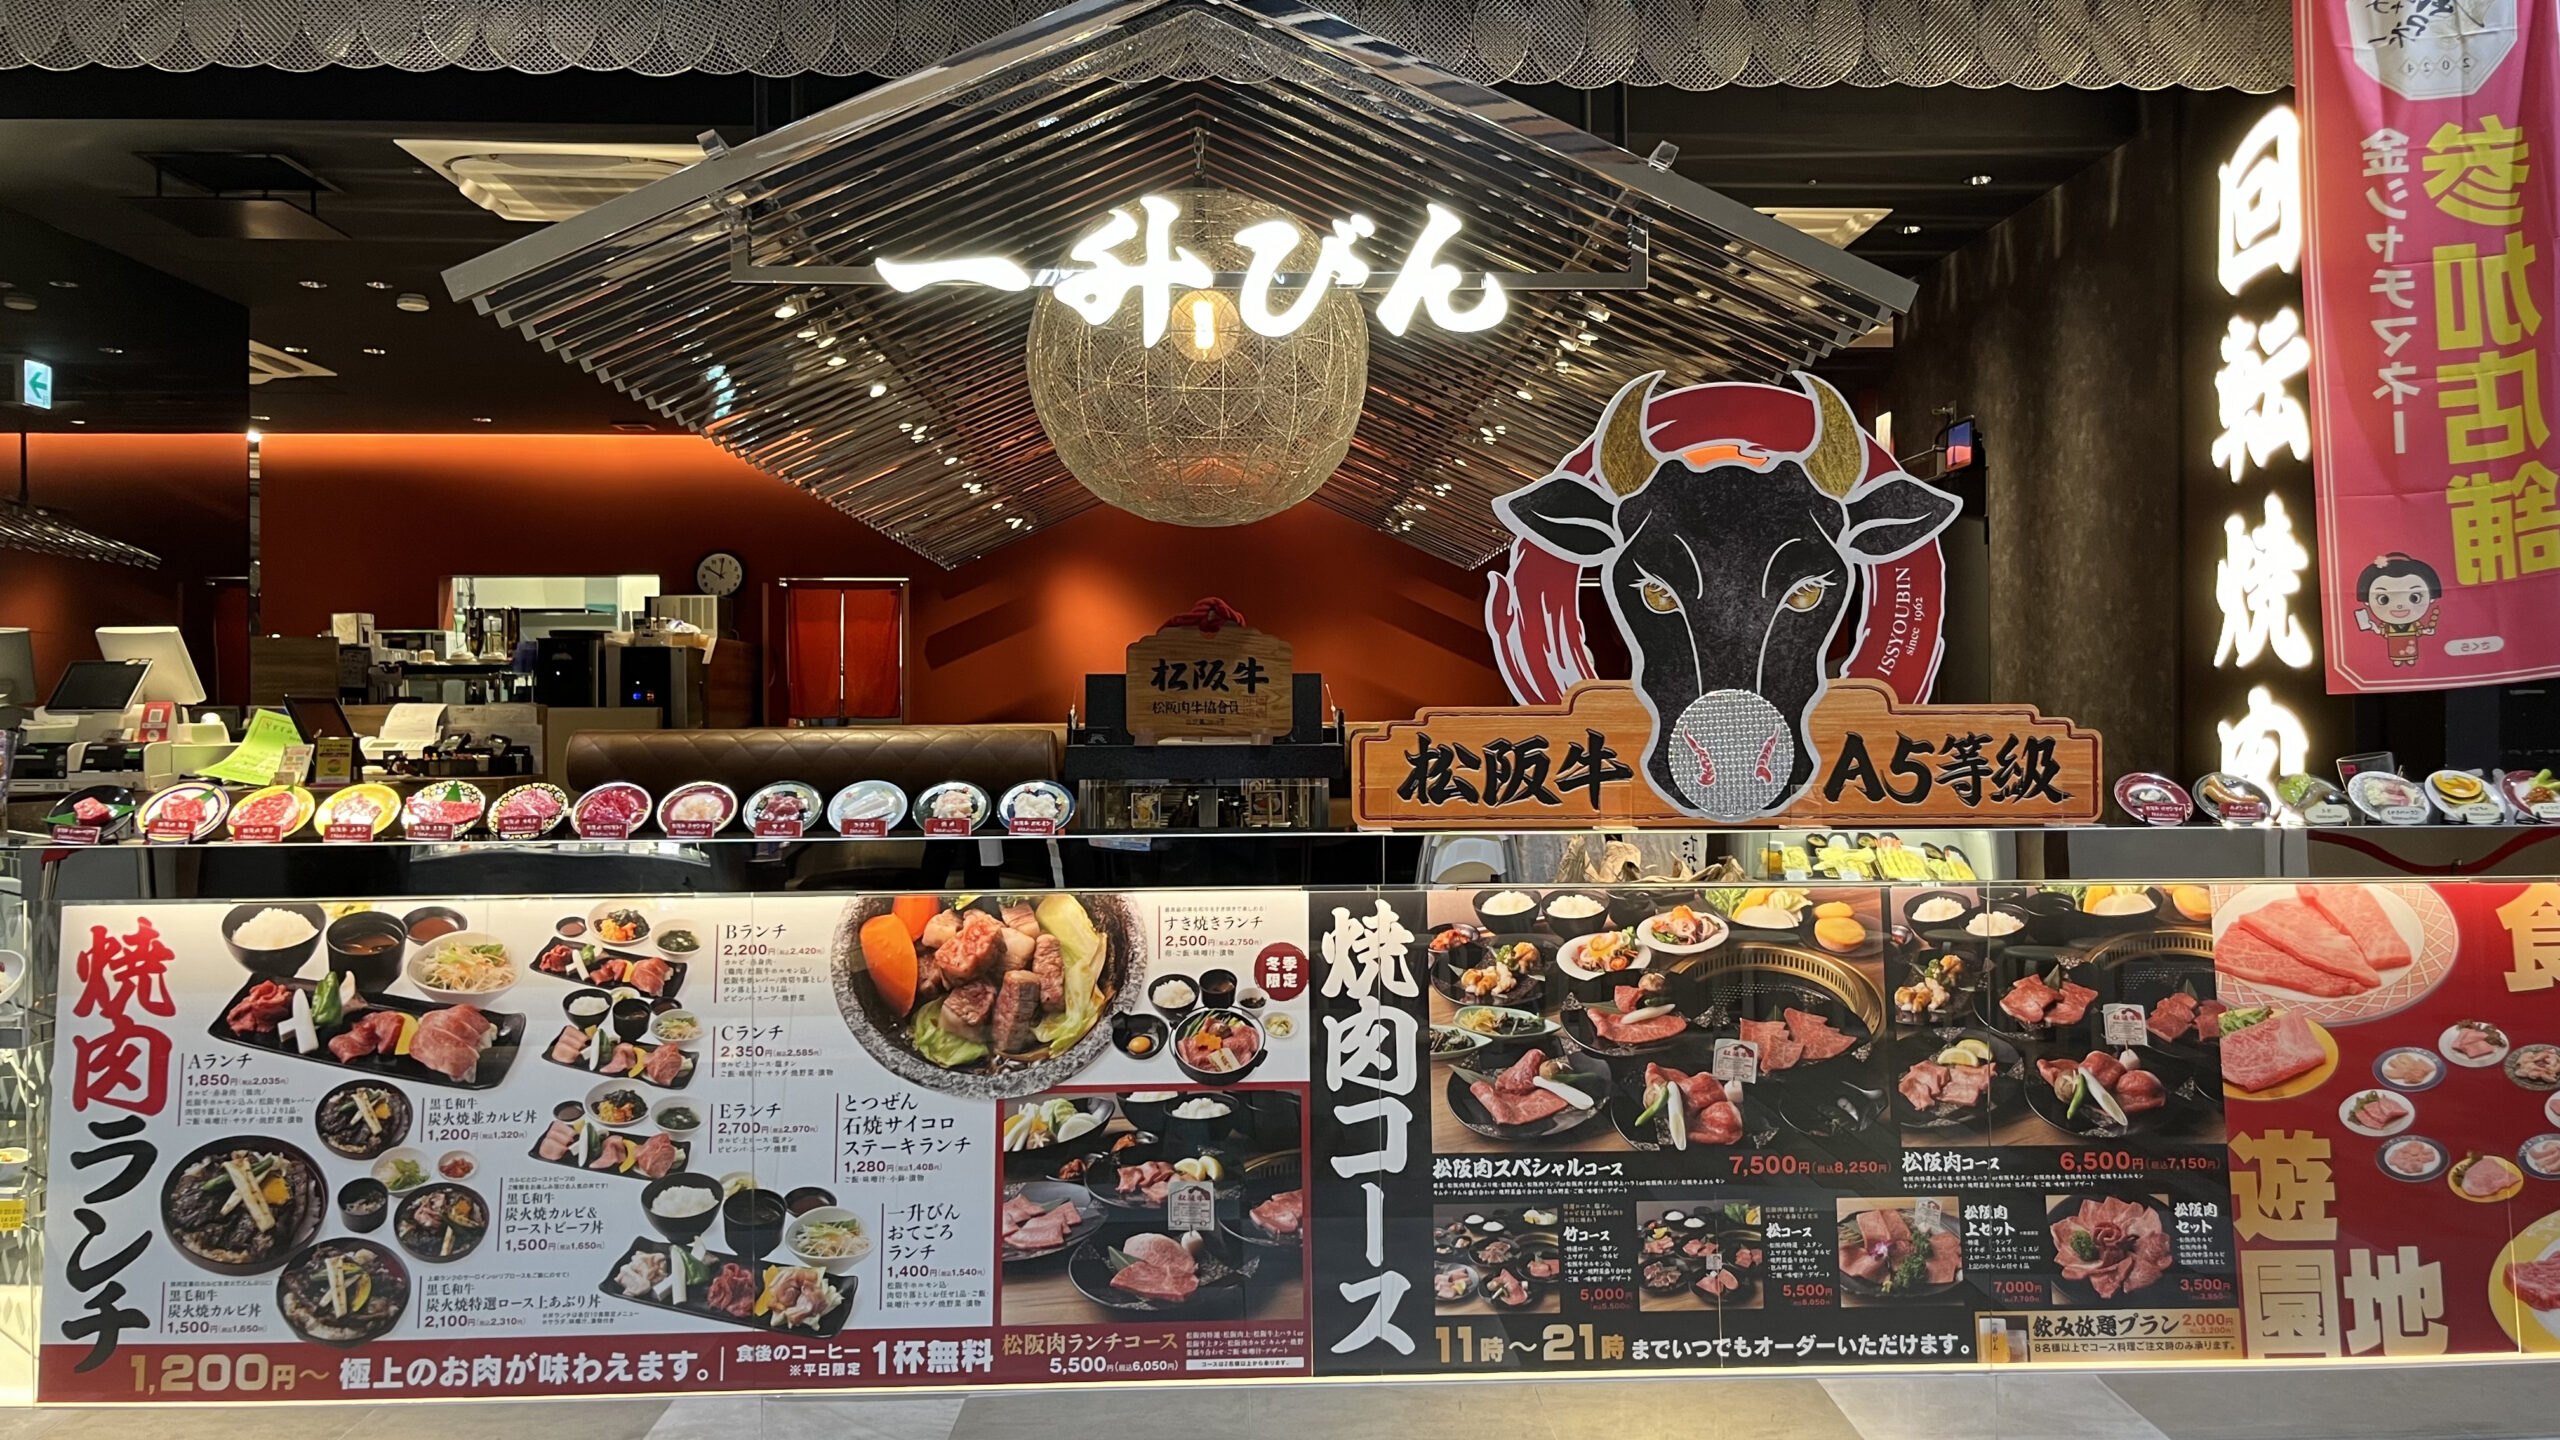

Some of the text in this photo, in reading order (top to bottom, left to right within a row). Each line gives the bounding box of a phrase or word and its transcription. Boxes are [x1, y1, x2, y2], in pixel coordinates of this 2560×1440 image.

[875, 196, 1509, 349] 一升びん
[1877, 567, 1912, 676] ISSYOUBIN
[1906, 597, 1926, 656] since 1962
[1151, 657, 1270, 694] 松阪牛
[1398, 728, 1635, 807] 松阪牛
[1824, 730, 2077, 806] A5等級
[726, 923, 787, 940] Bランチ
[1164, 915, 1265, 931] すき焼きランチ
[1265, 956, 1298, 972] 冬季
[1265, 973, 1298, 989] 限定
[721, 1025, 784, 1041] Cランチ
[188, 1052, 253, 1070] Aランチ
[429, 1098, 479, 1111] 黒毛和牛
[720, 1102, 782, 1119] Eランチ
[844, 1091, 919, 1112] とつぜん
[428, 1110, 538, 1127] 炭火焼並カルビ丼
[843, 1115, 955, 1136] 石焼サイコロ
[1320, 899, 1420, 1356] 焼肉コース
[60, 917, 177, 1374] 焼肉ランチ
[843, 1136, 972, 1157] ステーキランチ
[1432, 1156, 1625, 1180] 松阪肉スペシャルコース
[1901, 1150, 2000, 1173] 松阪肉コース
[506, 1192, 555, 1205] 黒毛和牛
[887, 1203, 960, 1222] 一升びん
[1964, 1204, 2008, 1220] 松阪肉
[2174, 1201, 2218, 1218] 松阪肉
[505, 1220, 604, 1236] ローストビーフ丼
[887, 1223, 954, 1241] おてごろ
[1563, 1225, 1610, 1242] 竹コース
[1766, 1222, 1813, 1239] 松コース
[1964, 1220, 2016, 1237] 上セット
[2176, 1219, 2213, 1234] セット
[888, 1244, 936, 1262] ランチ
[169, 1289, 218, 1302] 黒毛和牛
[426, 1283, 475, 1296] 黒毛和牛
[167, 1304, 262, 1318] 炭火焼カルビ丼
[426, 1293, 602, 1312] 炭火焼特選ロース上あぶり丼
[2032, 1312, 2233, 1338] 飲み放題プラン 2,000円
[736, 1343, 861, 1363] 食後のコーヒー
[1001, 1332, 1179, 1356] 松阪肉ランチコース
[1631, 1333, 1970, 1361] までいつでもオーダーいただけます。
[2034, 1340, 2237, 1354] 8名様以上でコース料理ご注文時のみ承ります。
[872, 1338, 994, 1377] 1杯無料
[340, 1350, 709, 1390] 極上のお肉が味わえます。
[789, 1362, 861, 1378] ※平日限定
